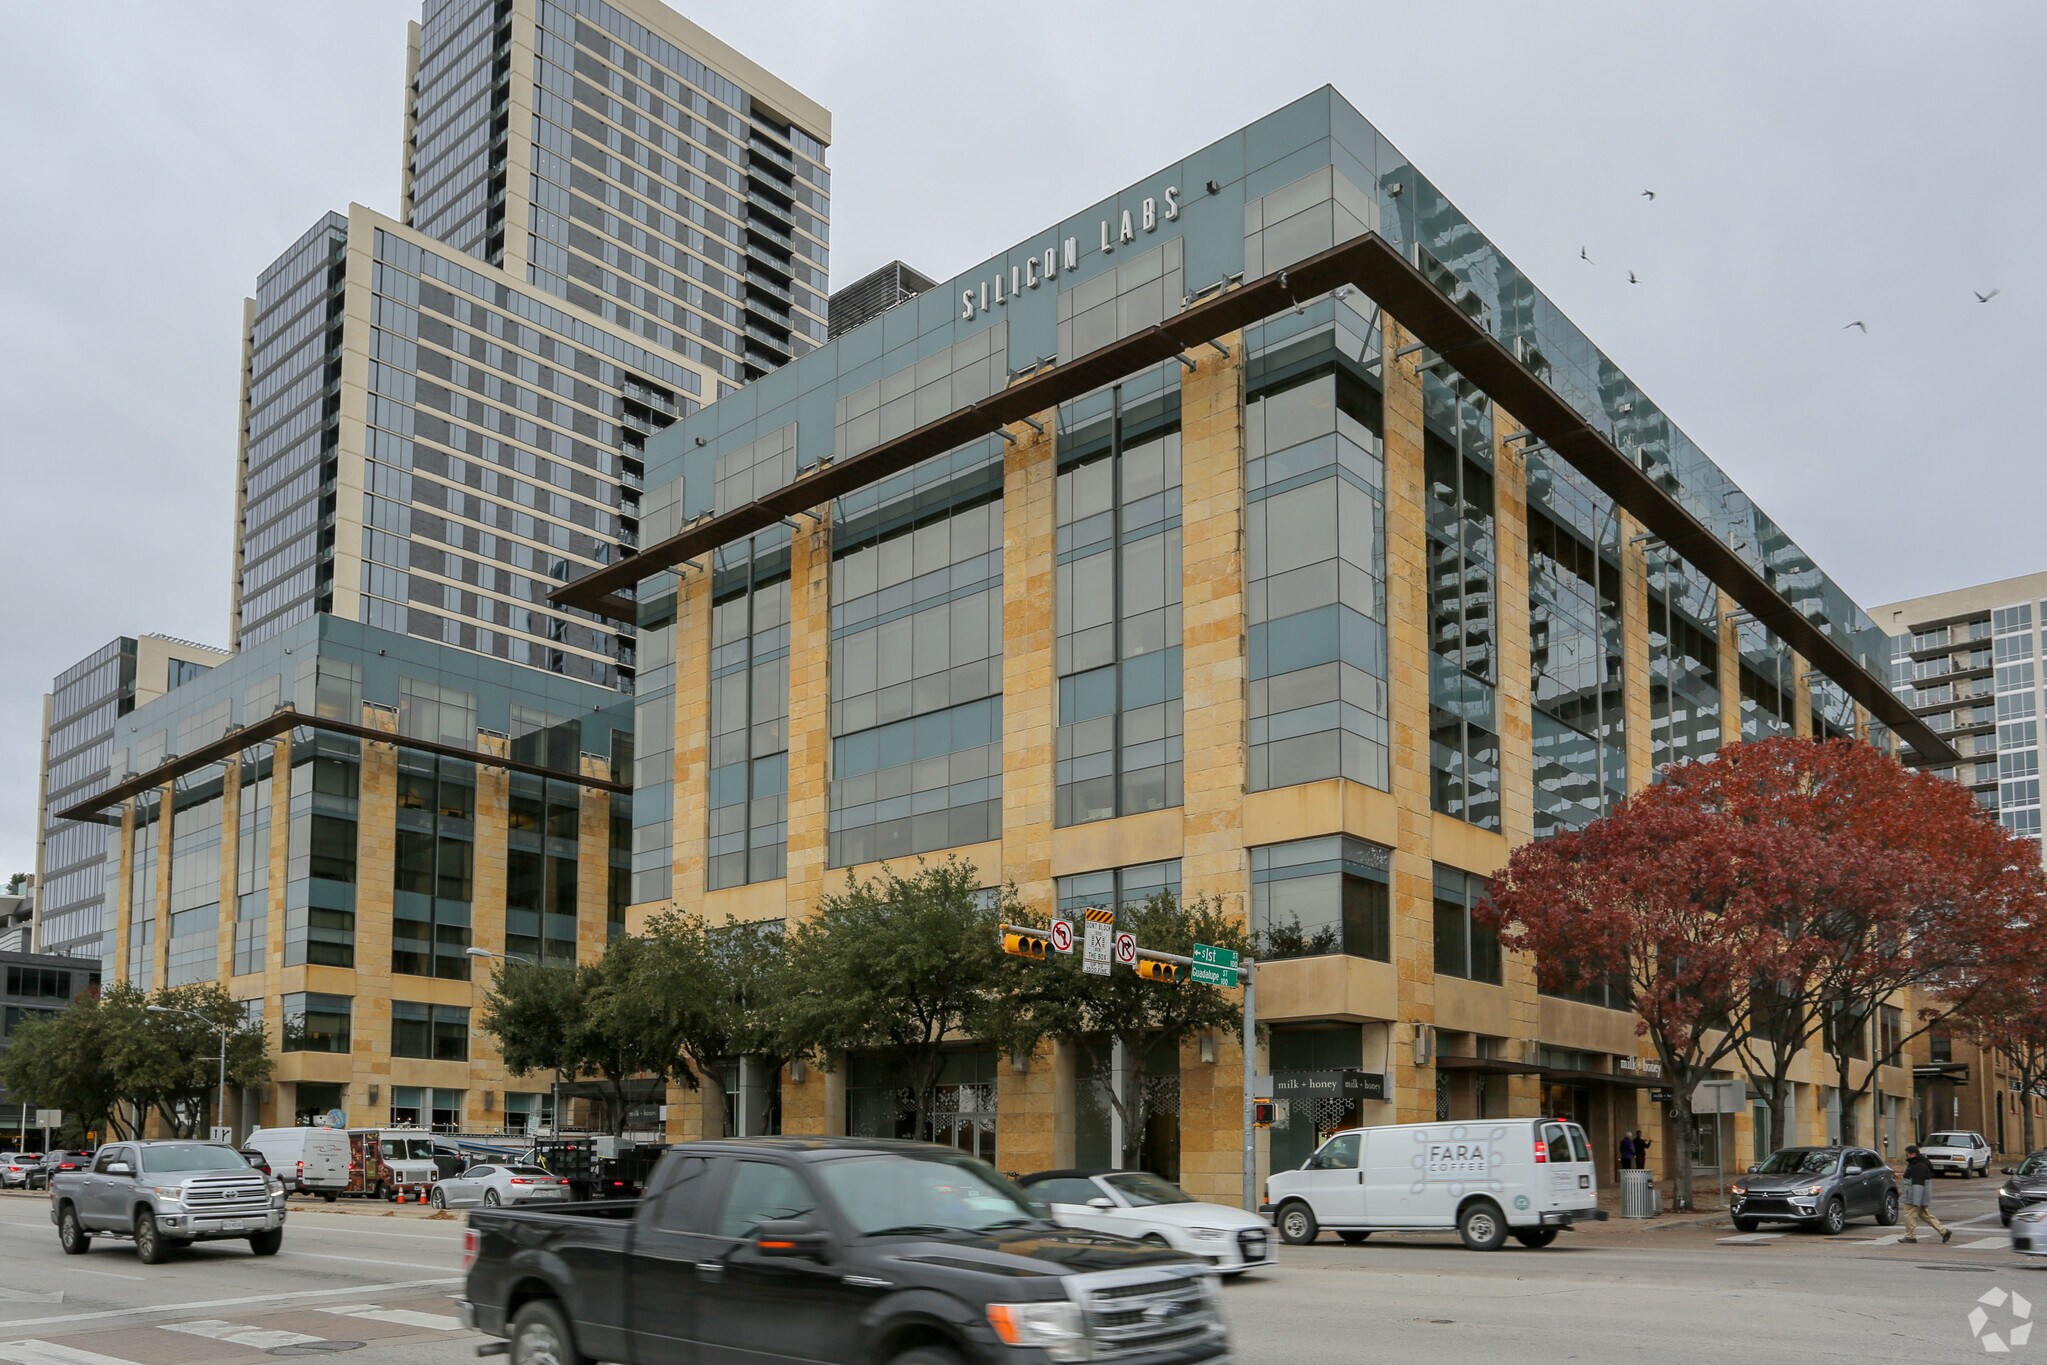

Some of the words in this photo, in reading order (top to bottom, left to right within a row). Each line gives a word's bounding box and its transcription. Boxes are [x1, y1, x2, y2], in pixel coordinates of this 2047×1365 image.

[962, 236, 1077, 321] SILICON
[1101, 185, 1180, 253] LABS
[1232, 952, 1239, 960] ST
[1230, 960, 1238, 968] 100
[1192, 967, 1220, 983] Guadalupe
[1222, 969, 1228, 977] ST
[1220, 978, 1229, 986] 100
[1620, 1055, 1637, 1070] milk
[1642, 1057, 1662, 1078] honey
[1278, 1078, 1299, 1089] milk
[1309, 1078, 1337, 1091] honey
[1345, 1078, 1359, 1089] milk
[1364, 1079, 1381, 1094] honey
[1429, 1144, 1485, 1161] FARA
[1429, 1162, 1485, 1172] COFFEE
